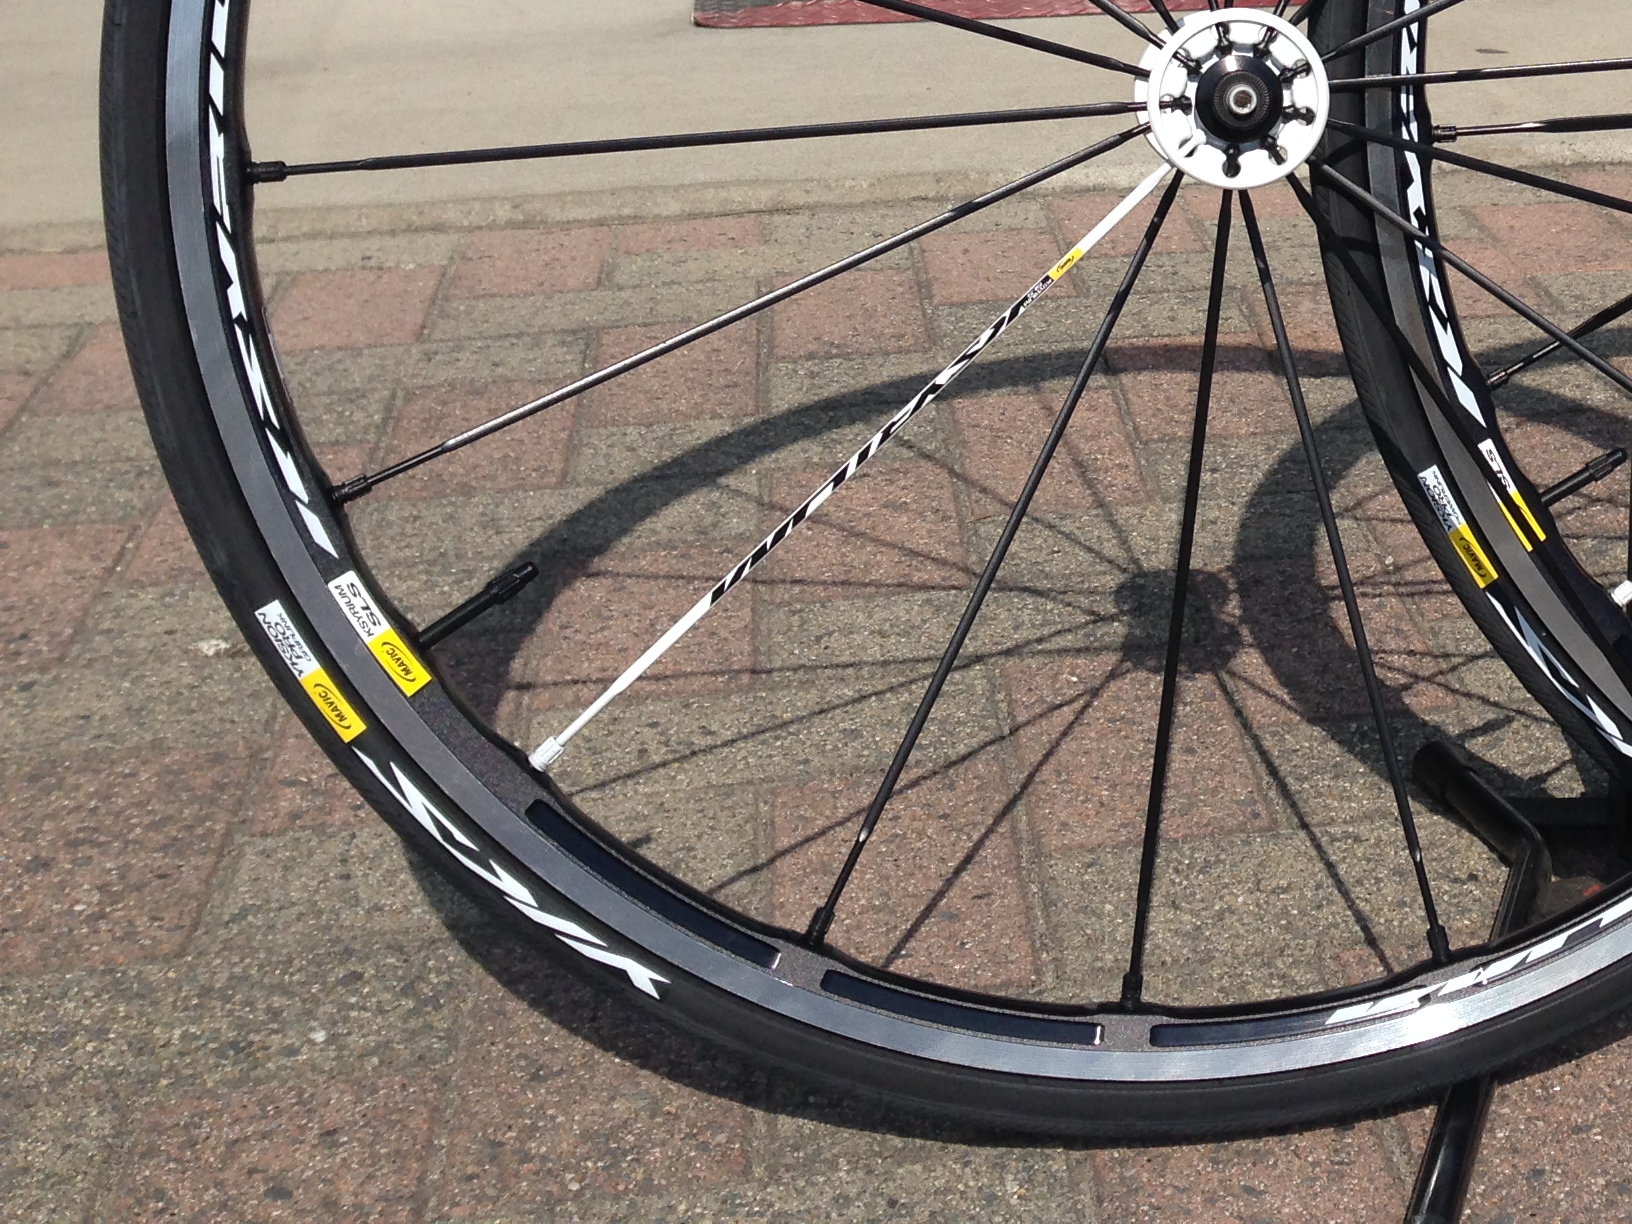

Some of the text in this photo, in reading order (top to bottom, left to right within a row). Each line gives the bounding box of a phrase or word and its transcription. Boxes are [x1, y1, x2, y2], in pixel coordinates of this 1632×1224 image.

[1462, 544, 1485, 573] MAVIC
[334, 584, 375, 638] KSYRIUM
[346, 582, 382, 627] SLS
[258, 612, 305, 677] YKSION
[274, 620, 303, 661] PRO
[386, 646, 414, 677] MAVIC
[317, 689, 348, 723] MAVIC
